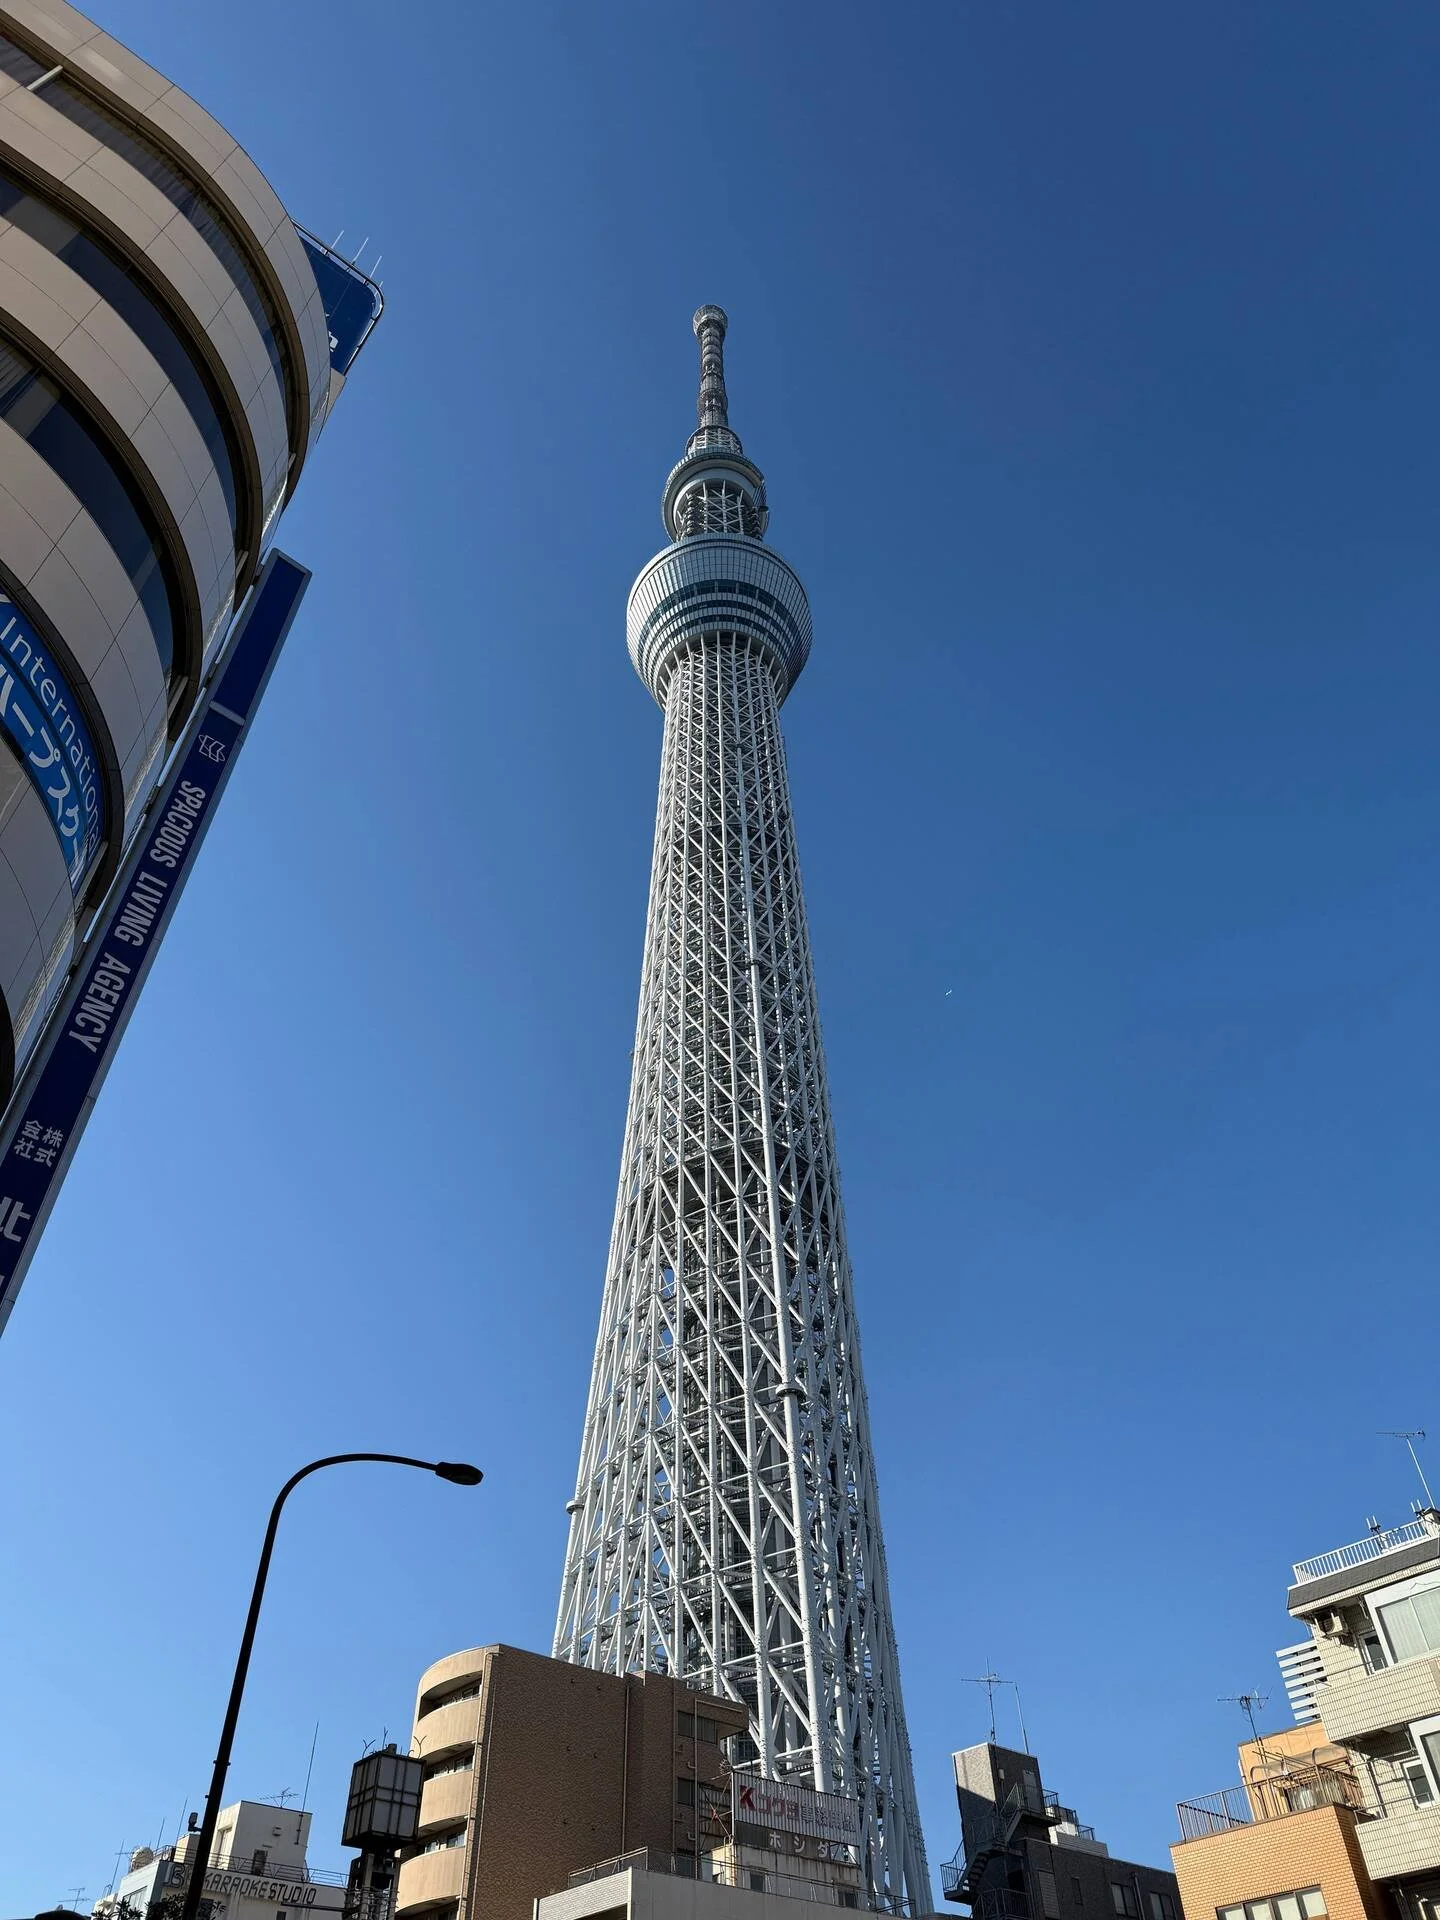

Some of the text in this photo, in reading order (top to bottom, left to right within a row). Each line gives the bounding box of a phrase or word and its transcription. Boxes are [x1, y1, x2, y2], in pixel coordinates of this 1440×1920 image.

[68, 780, 206, 1053] SPACIOUS LIVING AGENCY
